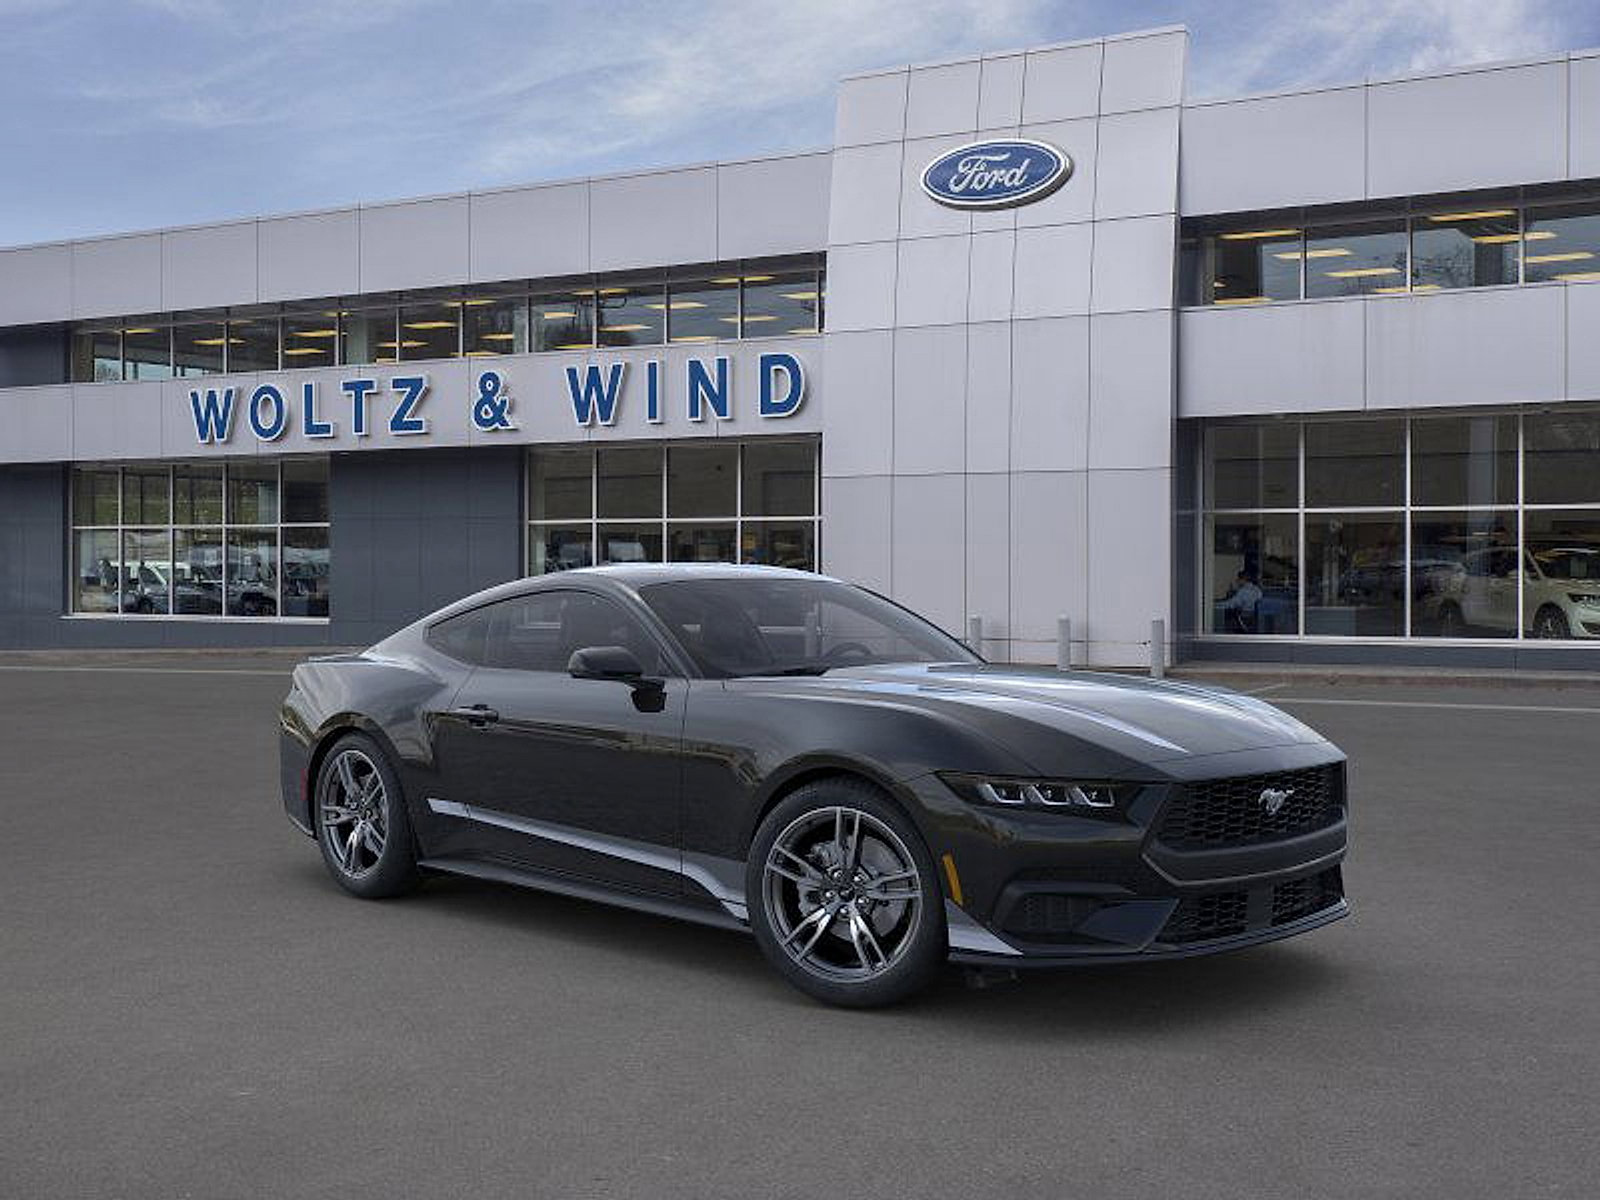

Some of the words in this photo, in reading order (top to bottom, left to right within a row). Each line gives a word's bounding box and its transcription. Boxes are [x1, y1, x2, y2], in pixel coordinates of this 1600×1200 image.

[950, 152, 1031, 193] Ford
[189, 374, 429, 443] WOLTZ
[472, 370, 515, 431] &
[566, 351, 806, 426] WIND
